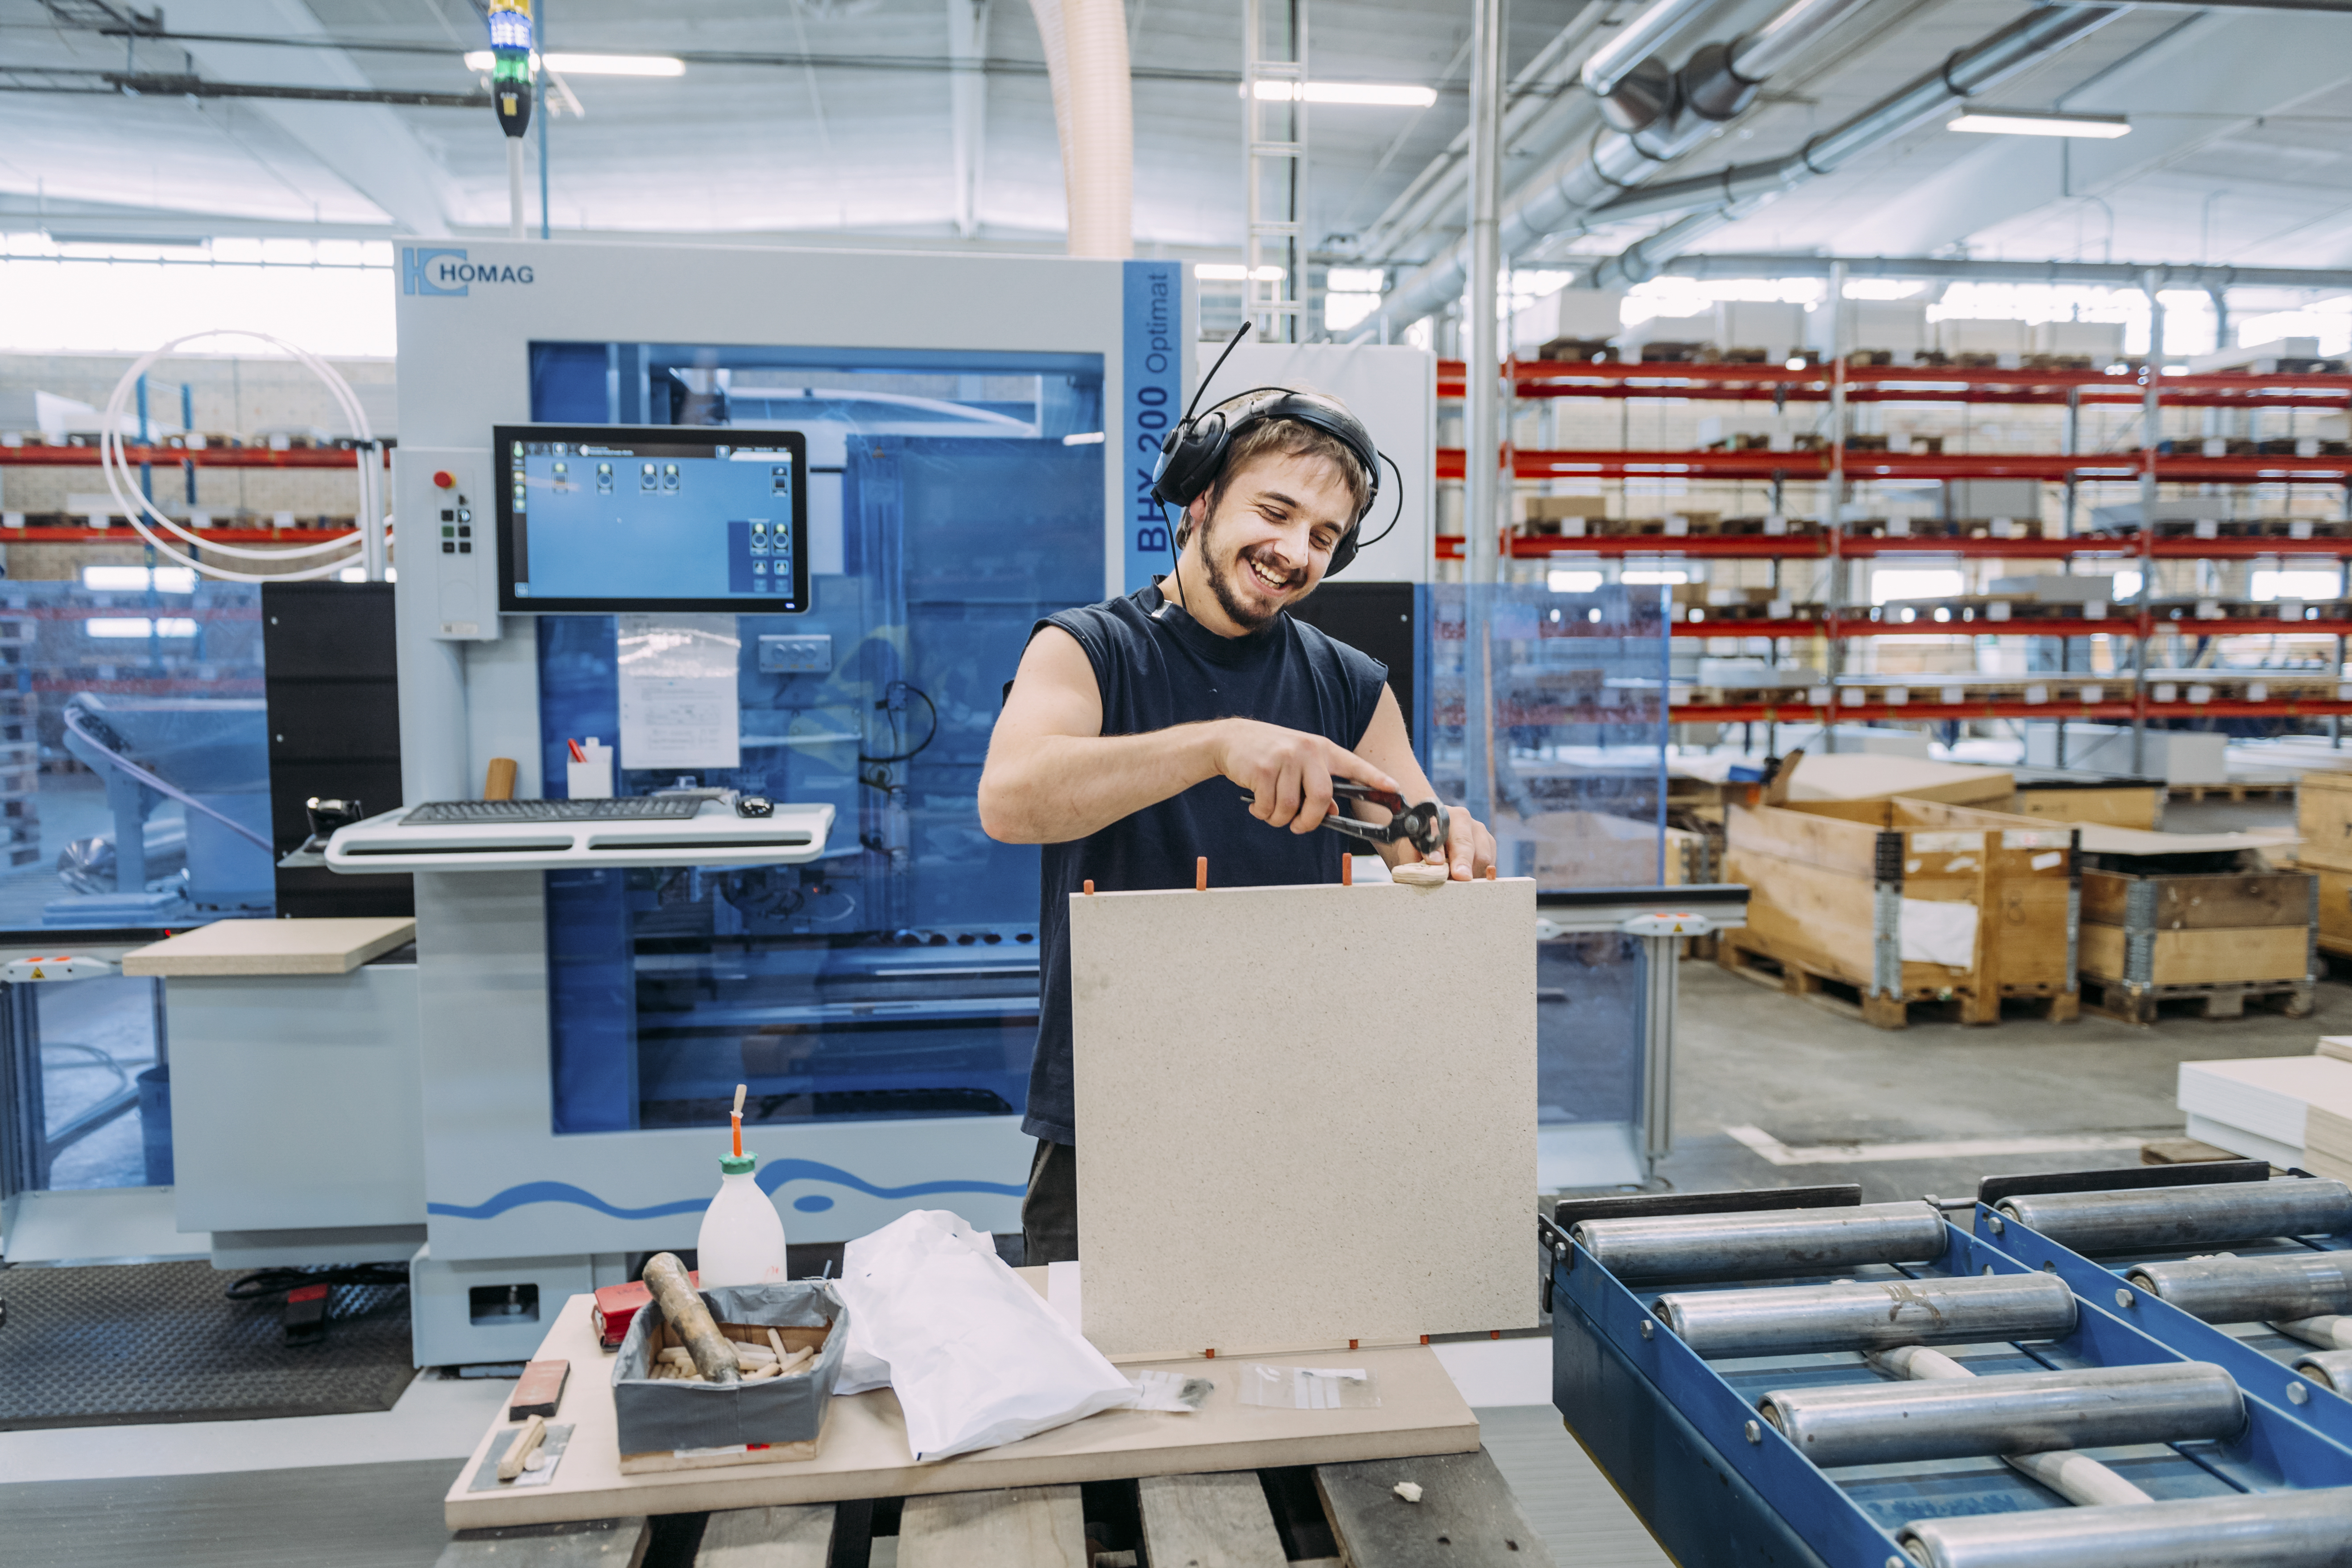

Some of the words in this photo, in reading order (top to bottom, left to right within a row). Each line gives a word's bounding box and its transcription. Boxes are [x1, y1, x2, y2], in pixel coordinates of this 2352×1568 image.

[440, 263, 534, 283] HOMAG
[1145, 273, 1173, 373] Optimat
[1137, 386, 1167, 452] 200
